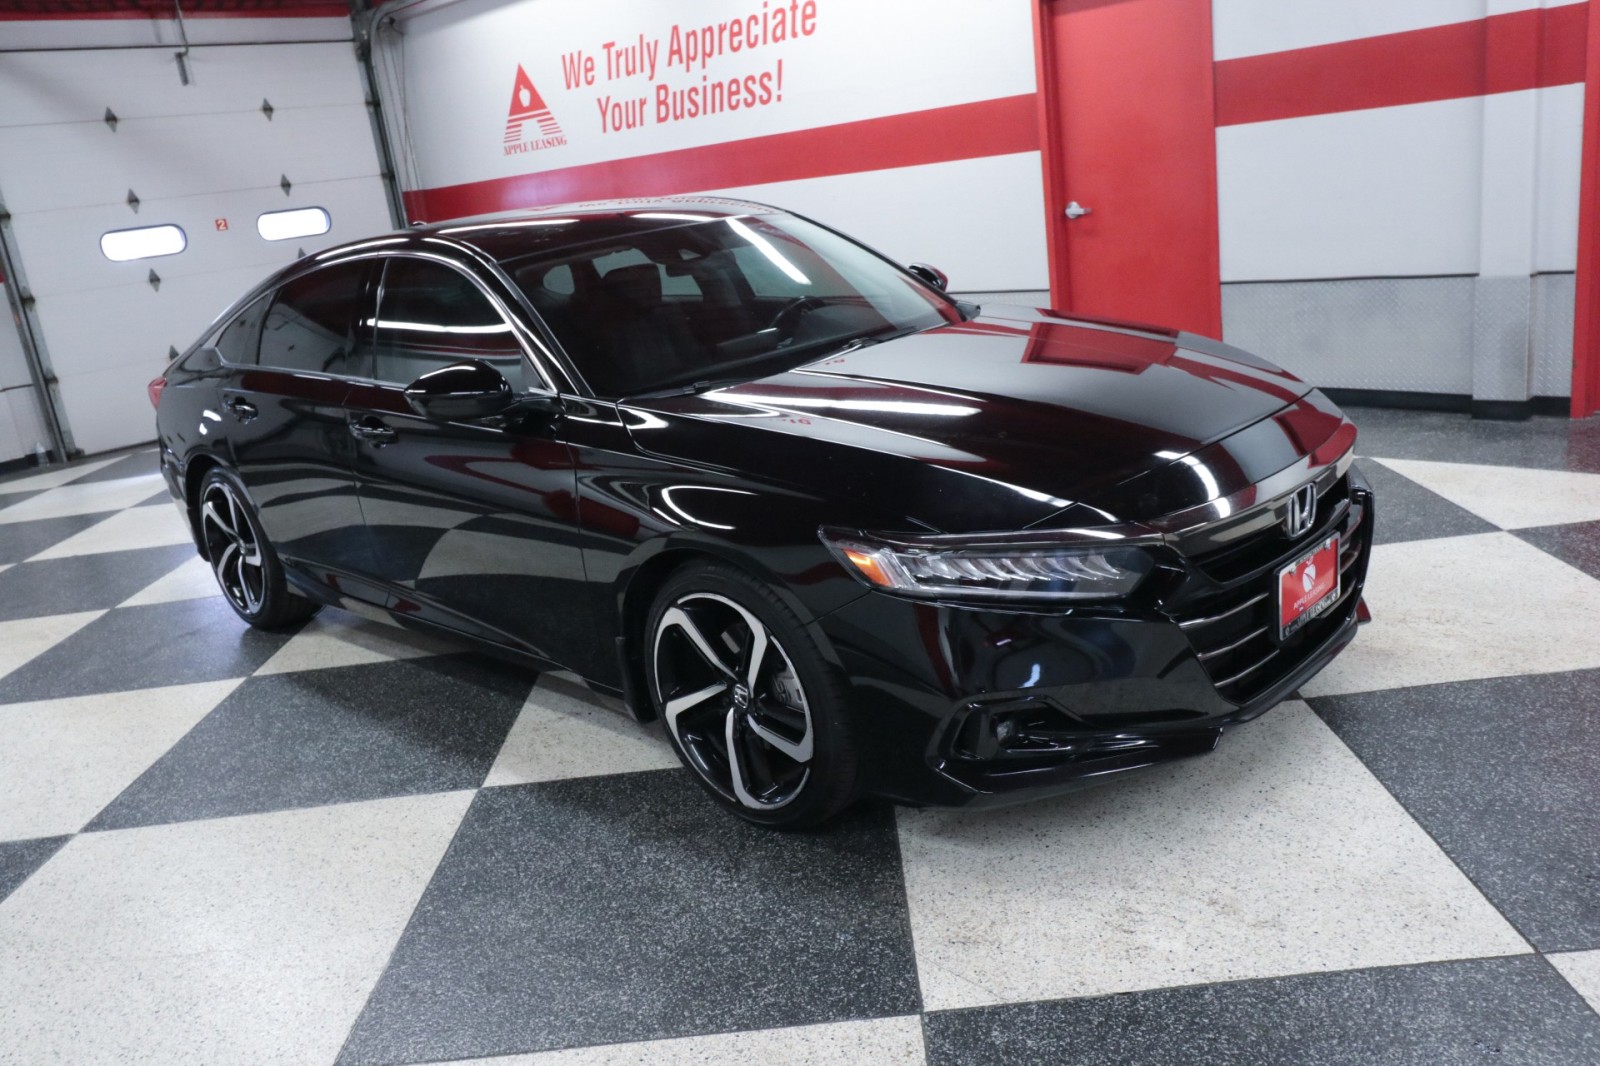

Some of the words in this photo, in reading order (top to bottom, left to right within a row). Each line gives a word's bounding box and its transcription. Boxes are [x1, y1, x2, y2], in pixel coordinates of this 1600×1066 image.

[562, 50, 595, 90] We
[602, 34, 659, 82] Truly
[667, 0, 817, 73] Appreciate
[597, 95, 647, 133] Your
[656, 59, 783, 124] Business!
[503, 140, 529, 156] APPLE
[530, 134, 567, 152] LEASING
[217, 220, 227, 230] 2
[1293, 596, 1309, 610] APPLE
